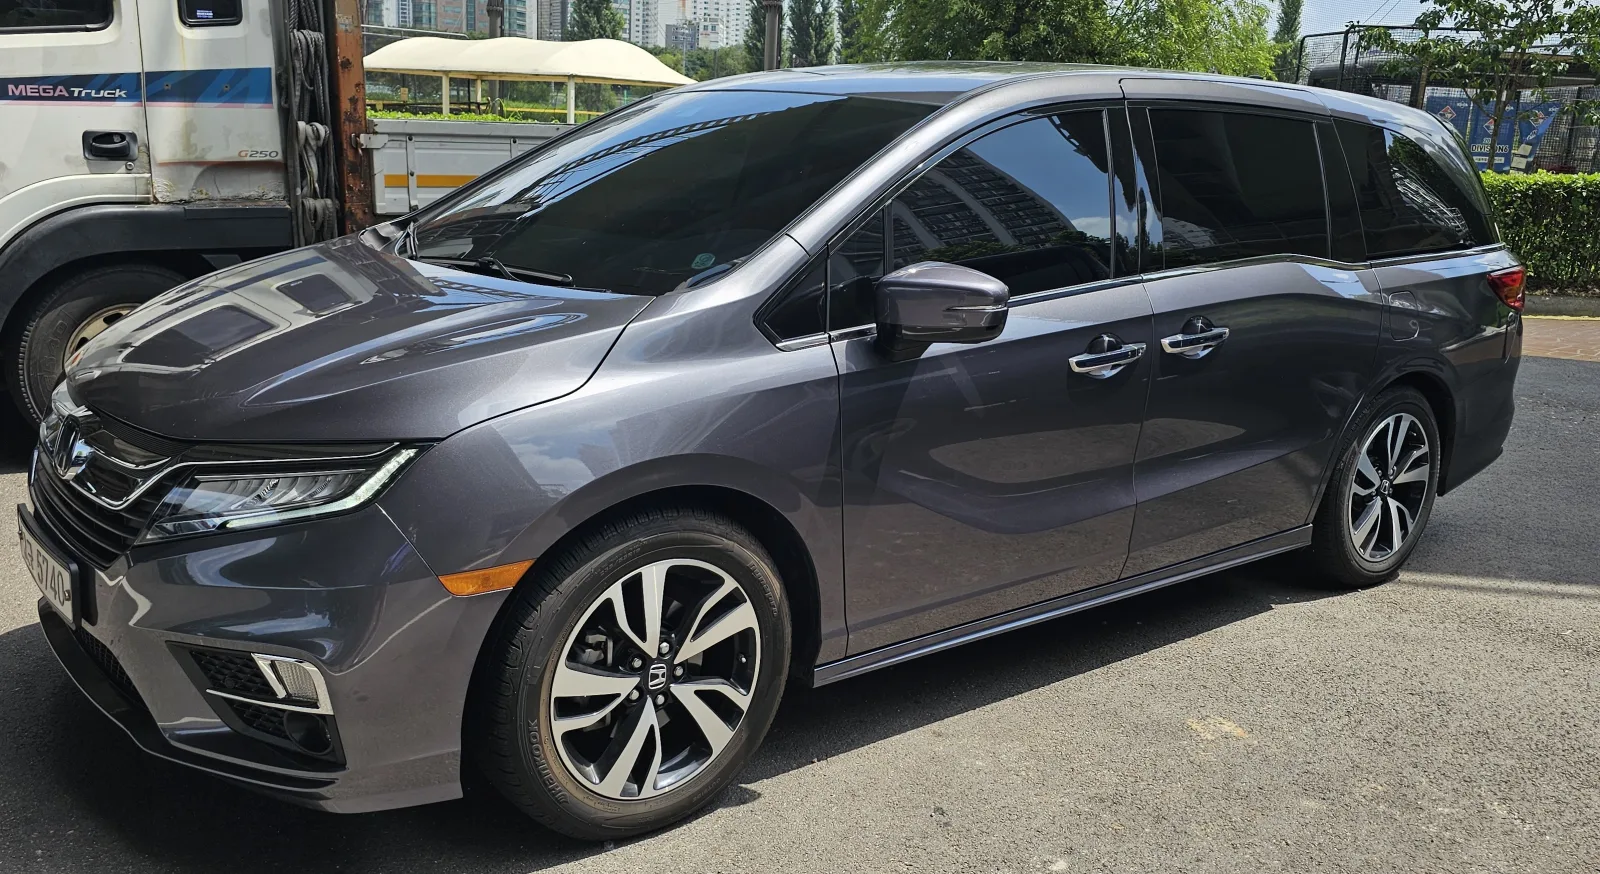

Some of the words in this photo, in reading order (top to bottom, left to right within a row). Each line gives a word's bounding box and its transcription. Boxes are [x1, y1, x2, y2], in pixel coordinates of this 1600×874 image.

[7, 84, 69, 97] MEGA
[70, 87, 127, 98] Truck
[238, 149, 279, 158] G250
[1471, 144, 1509, 153] DIVISN6
[36, 548, 65, 607] 5740
